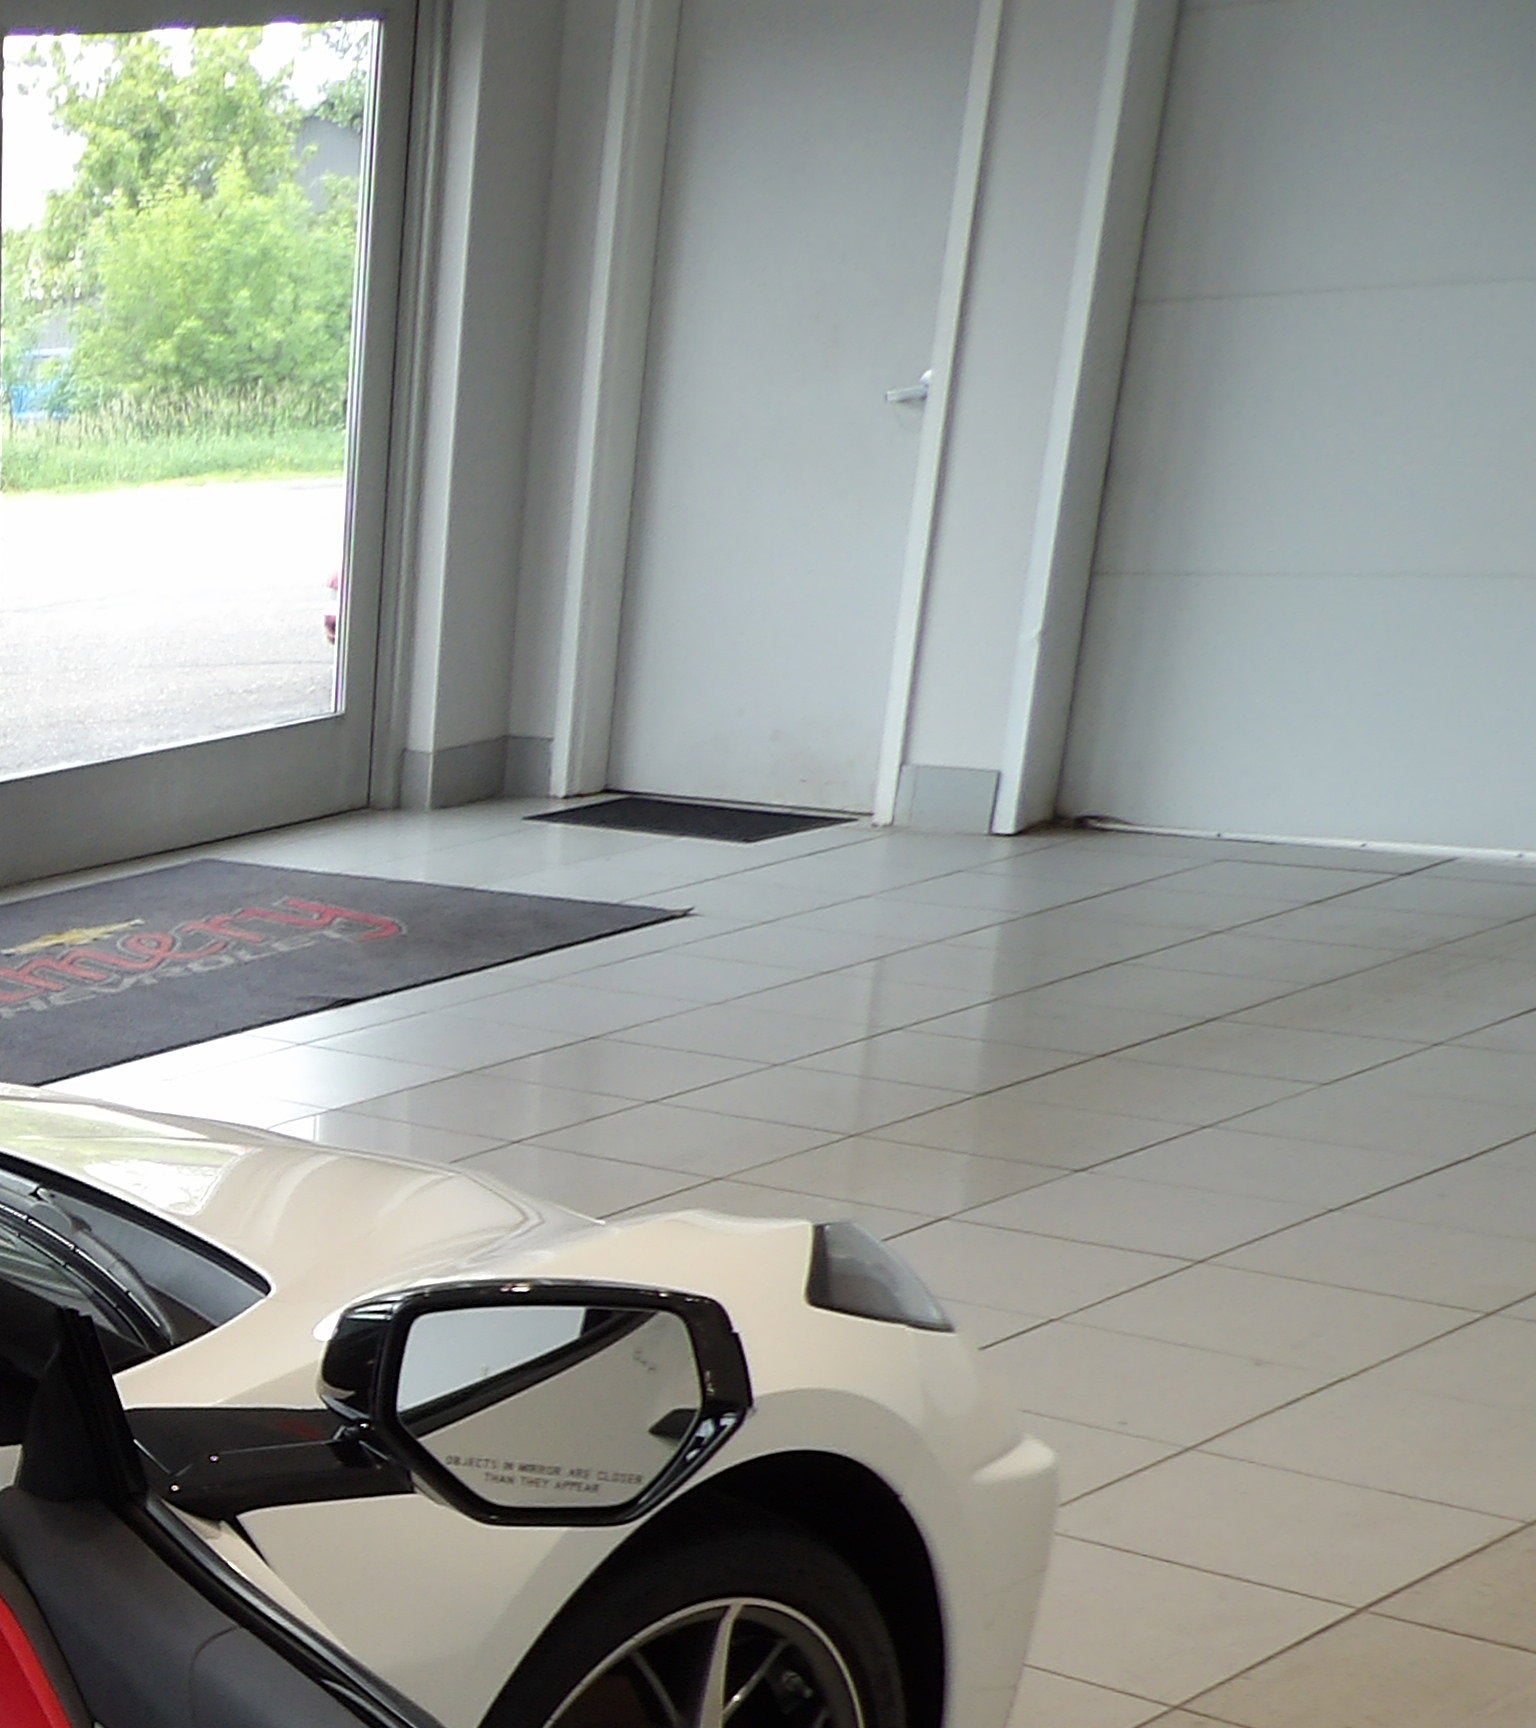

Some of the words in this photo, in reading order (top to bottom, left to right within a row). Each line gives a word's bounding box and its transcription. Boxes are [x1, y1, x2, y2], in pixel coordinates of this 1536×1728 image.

[445, 1455, 497, 1469] OBJECTS
[502, 1461, 514, 1471] IN
[517, 1462, 563, 1476] MIRROR
[569, 1468, 590, 1479] ARE
[596, 1470, 645, 1485] CLOSER
[484, 1470, 516, 1485] THAN
[519, 1475, 550, 1489] THEY
[554, 1481, 599, 1493] APPEAR
